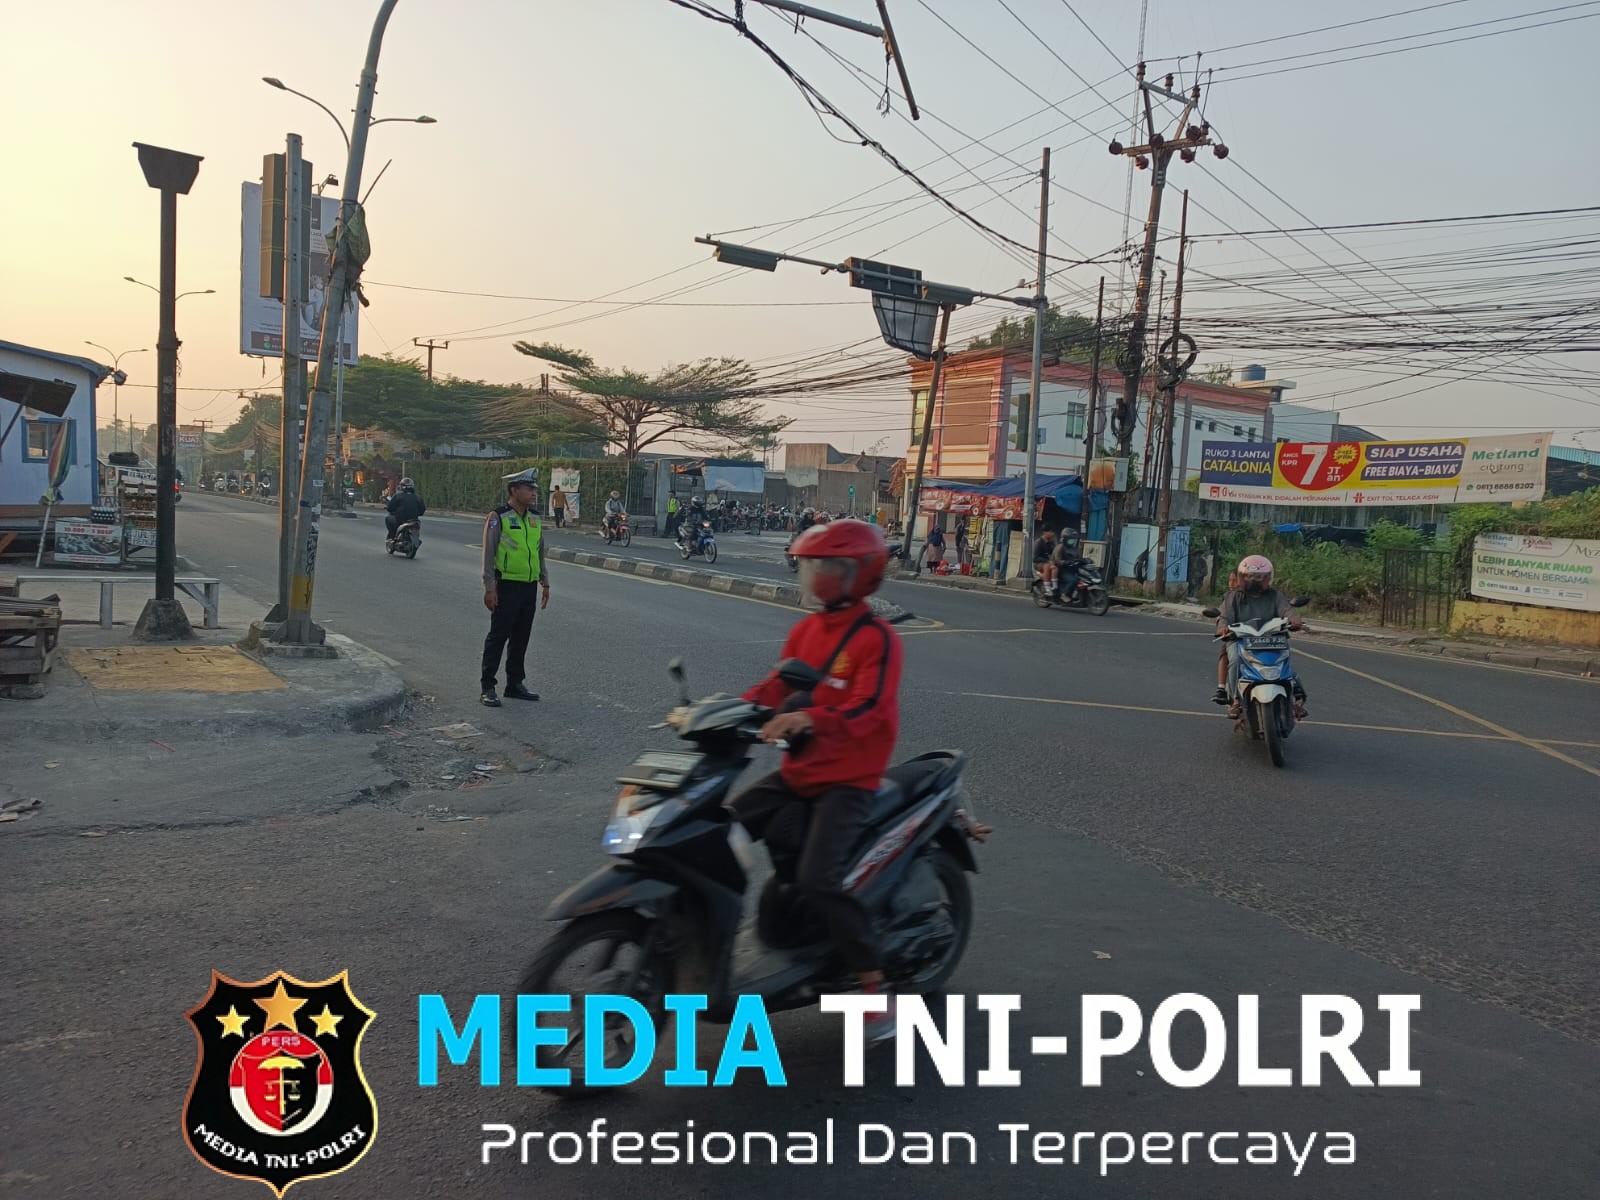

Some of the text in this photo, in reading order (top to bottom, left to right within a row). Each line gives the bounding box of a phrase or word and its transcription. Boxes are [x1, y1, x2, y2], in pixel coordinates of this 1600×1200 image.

[1205, 448, 1270, 459] RUKO 3 LANTAI
[1370, 444, 1463, 459] SIAP USAHA
[1472, 447, 1540, 461] Metland
[1203, 459, 1272, 474] CATALONIA
[1300, 444, 1329, 486] 7
[1327, 466, 1342, 475] JT
[1364, 465, 1388, 477] FREE
[1480, 463, 1525, 474] cibitung
[1478, 555, 1593, 574] LEBIH BANYAK RUANG
[1477, 566, 1590, 585] UNTUK MOMEN BERSAMA
